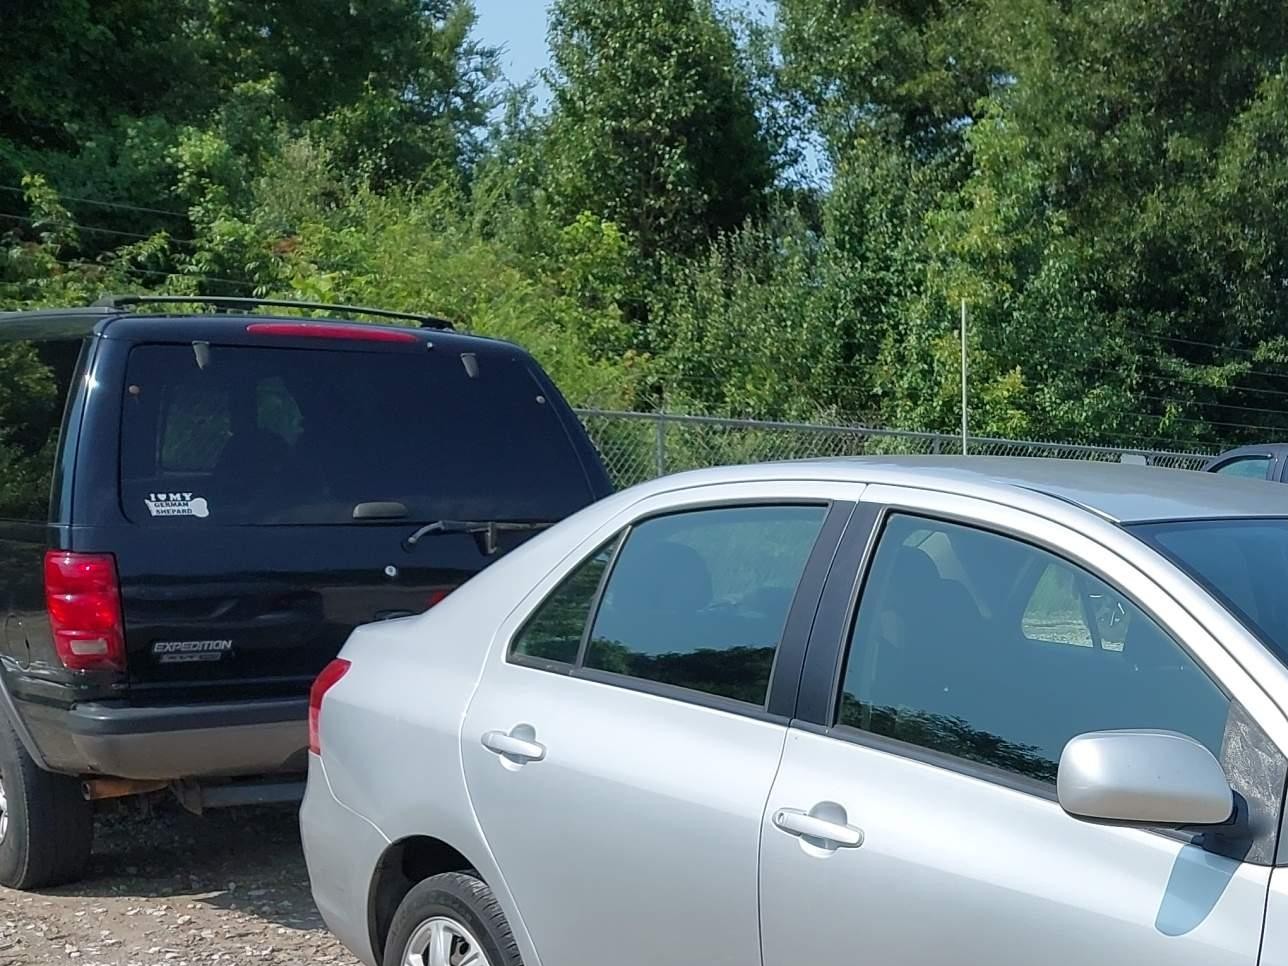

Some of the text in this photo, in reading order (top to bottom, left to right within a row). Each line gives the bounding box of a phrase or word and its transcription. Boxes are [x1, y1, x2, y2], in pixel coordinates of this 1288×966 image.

[149, 492, 192, 501] I MY
[153, 640, 233, 653] EXPEDITION
